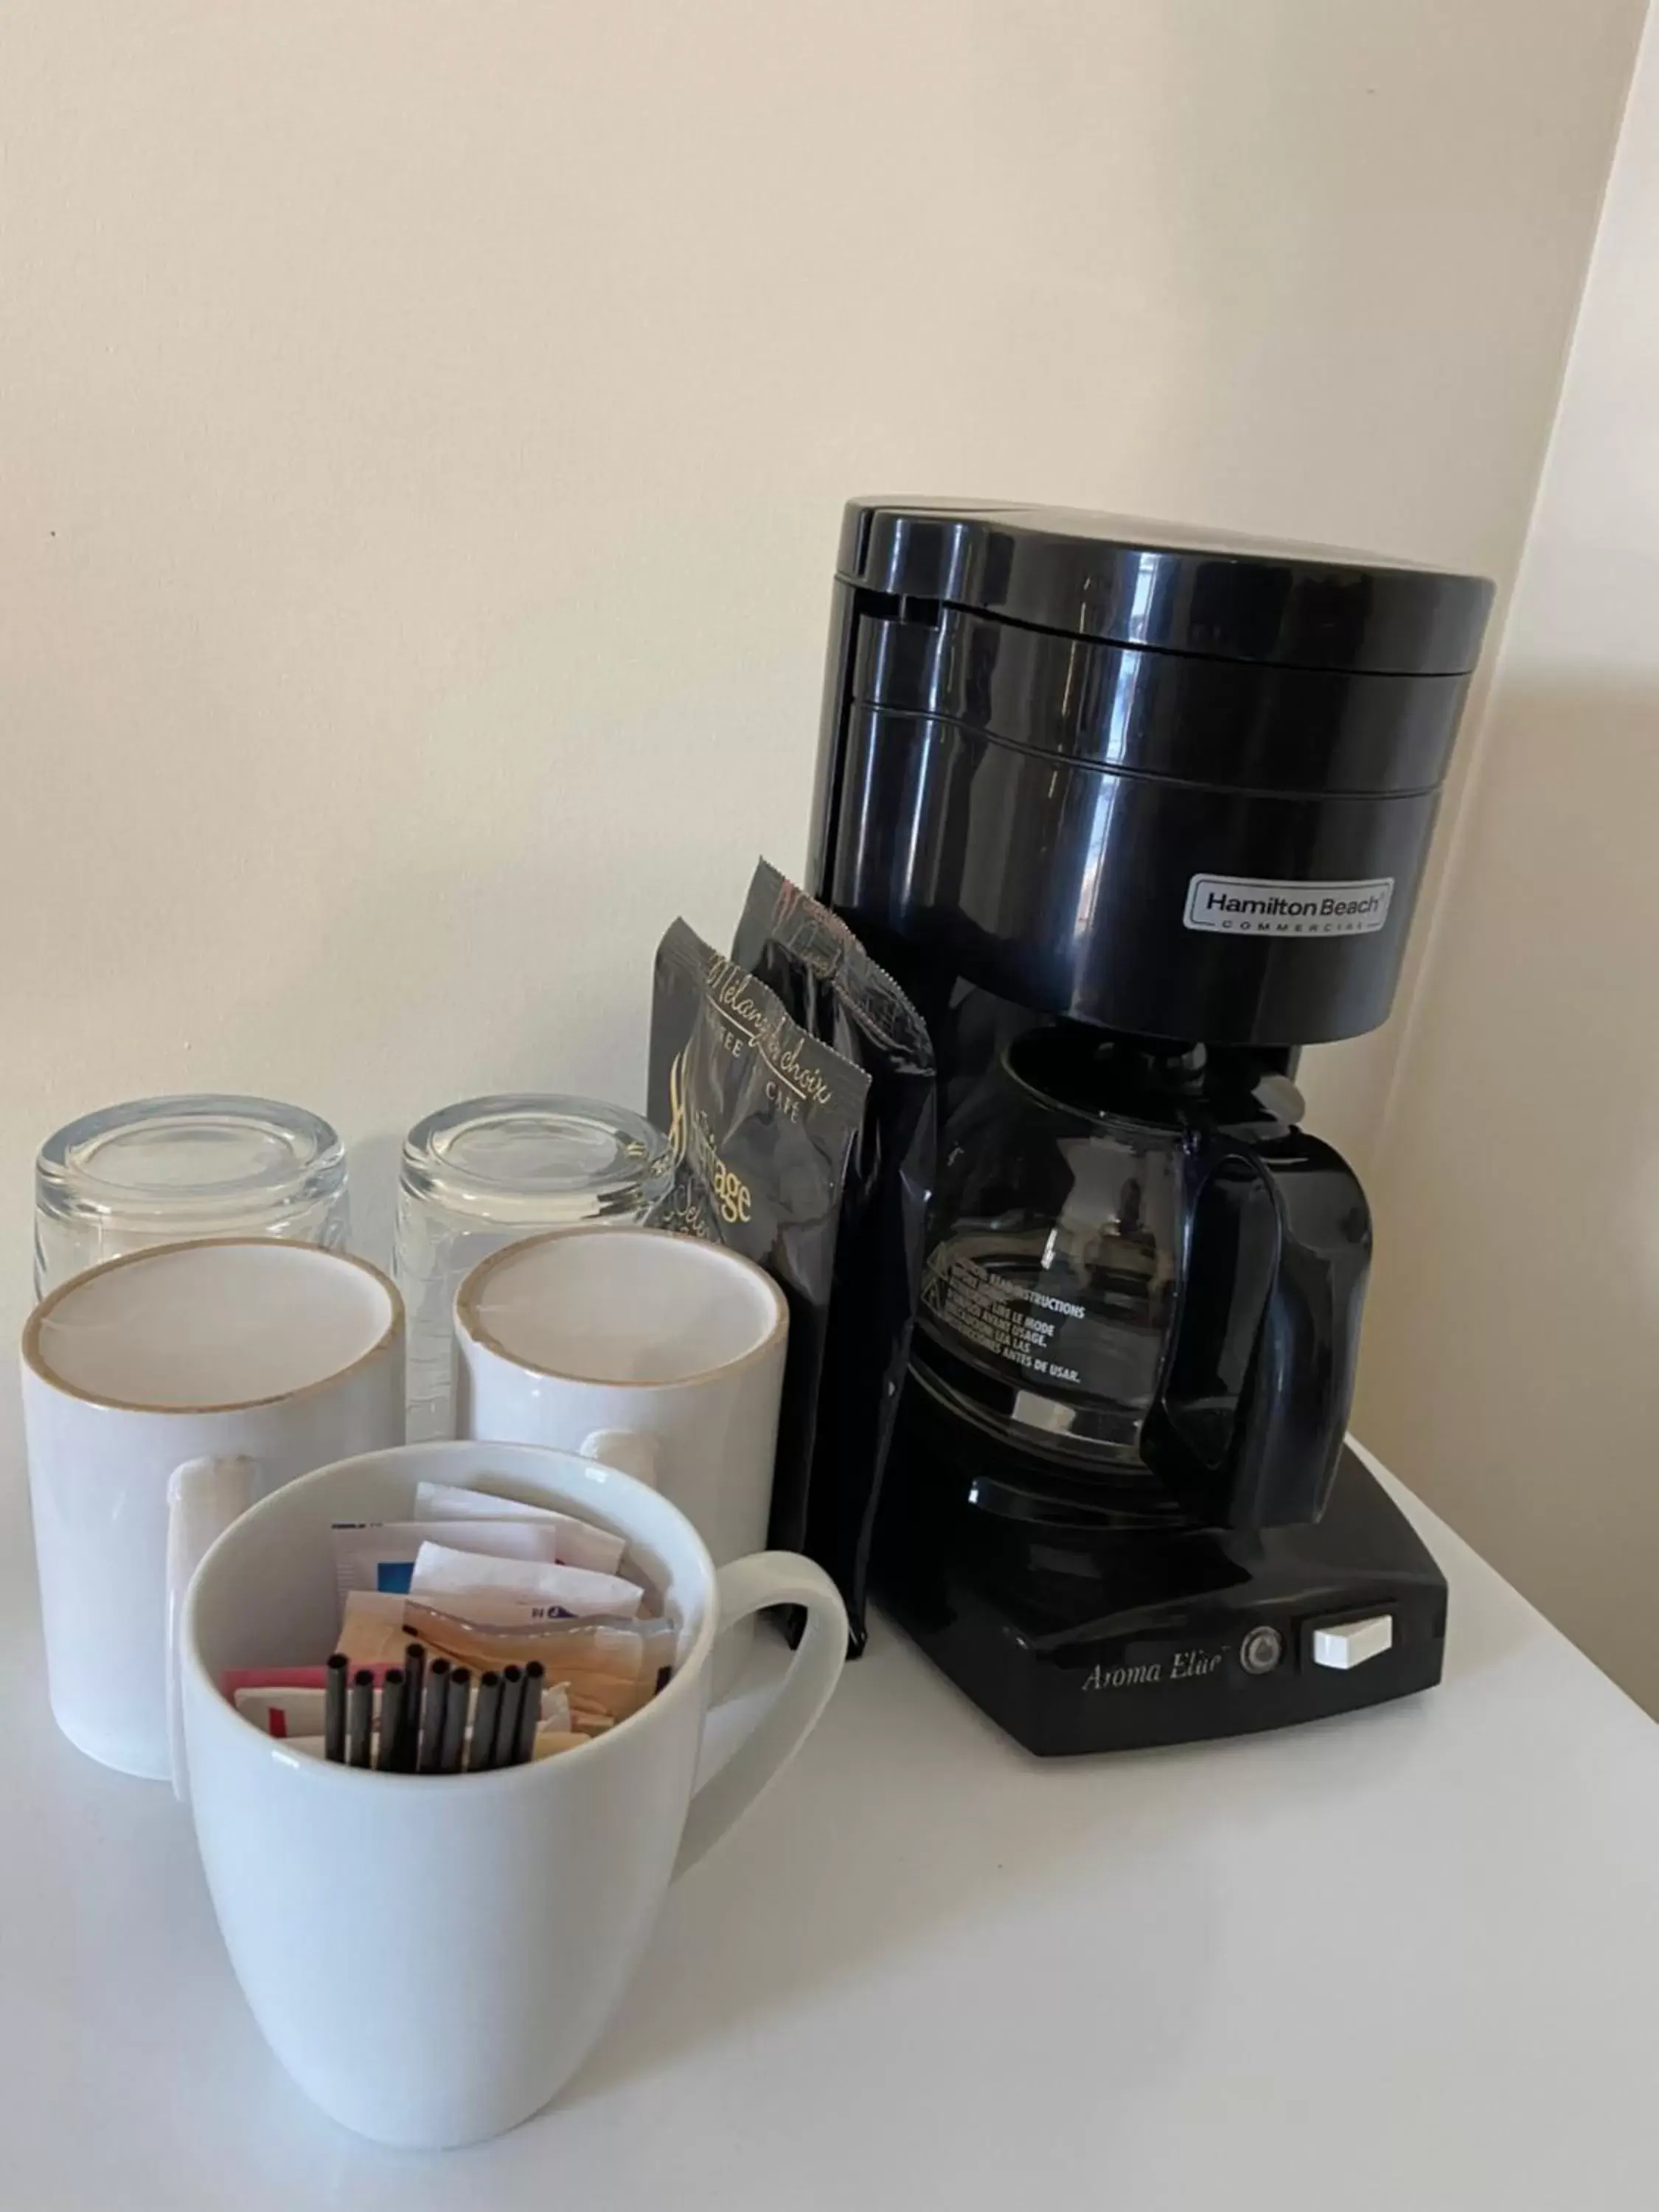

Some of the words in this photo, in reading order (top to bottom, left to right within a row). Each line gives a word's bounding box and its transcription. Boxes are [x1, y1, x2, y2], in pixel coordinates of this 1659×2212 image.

[1206, 891, 1317, 917] Hamilton
[1320, 895, 1379, 917] Beach
[1221, 919, 1363, 933] COMMERCIAL
[1081, 1663, 1162, 1691] Aroma
